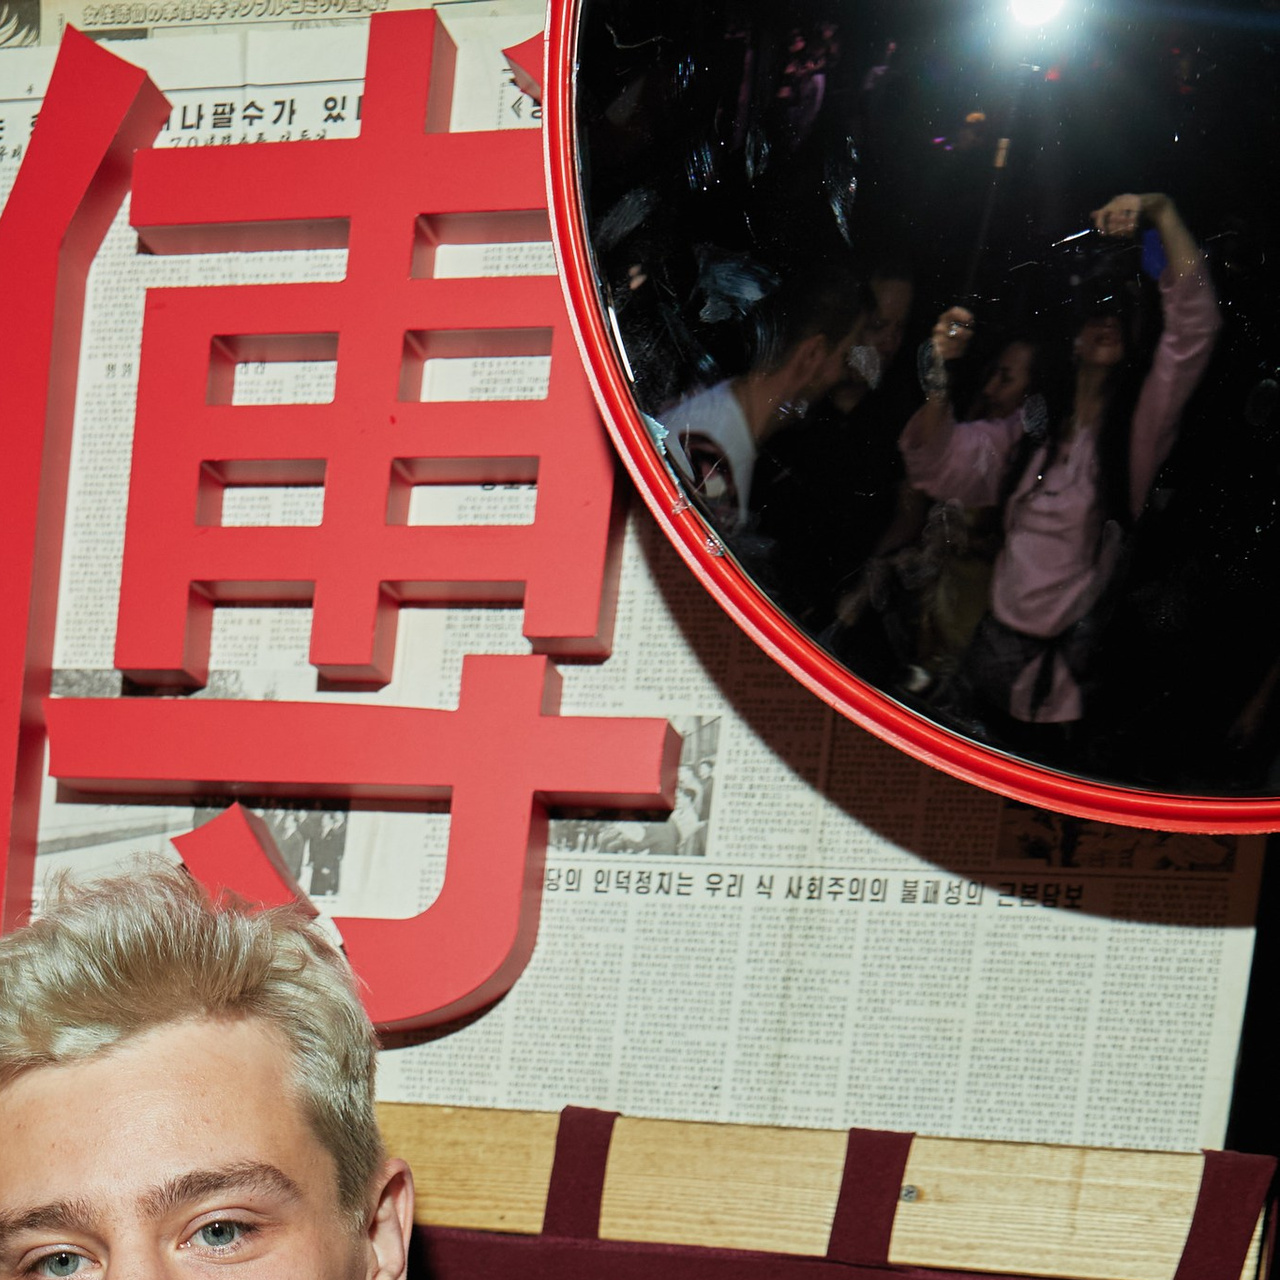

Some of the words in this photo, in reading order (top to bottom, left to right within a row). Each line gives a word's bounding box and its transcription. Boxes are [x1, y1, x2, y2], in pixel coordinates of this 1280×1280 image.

[163, 98, 296, 131] 나팔수가
[545, 867, 583, 893] 당의
[593, 868, 694, 897] 인덕정치는
[705, 872, 744, 899] 우리
[756, 874, 775, 900] 식
[785, 874, 888, 903] 사회주의의
[900, 878, 984, 907] 불패성의
[998, 881, 1085, 908] 근본담보
